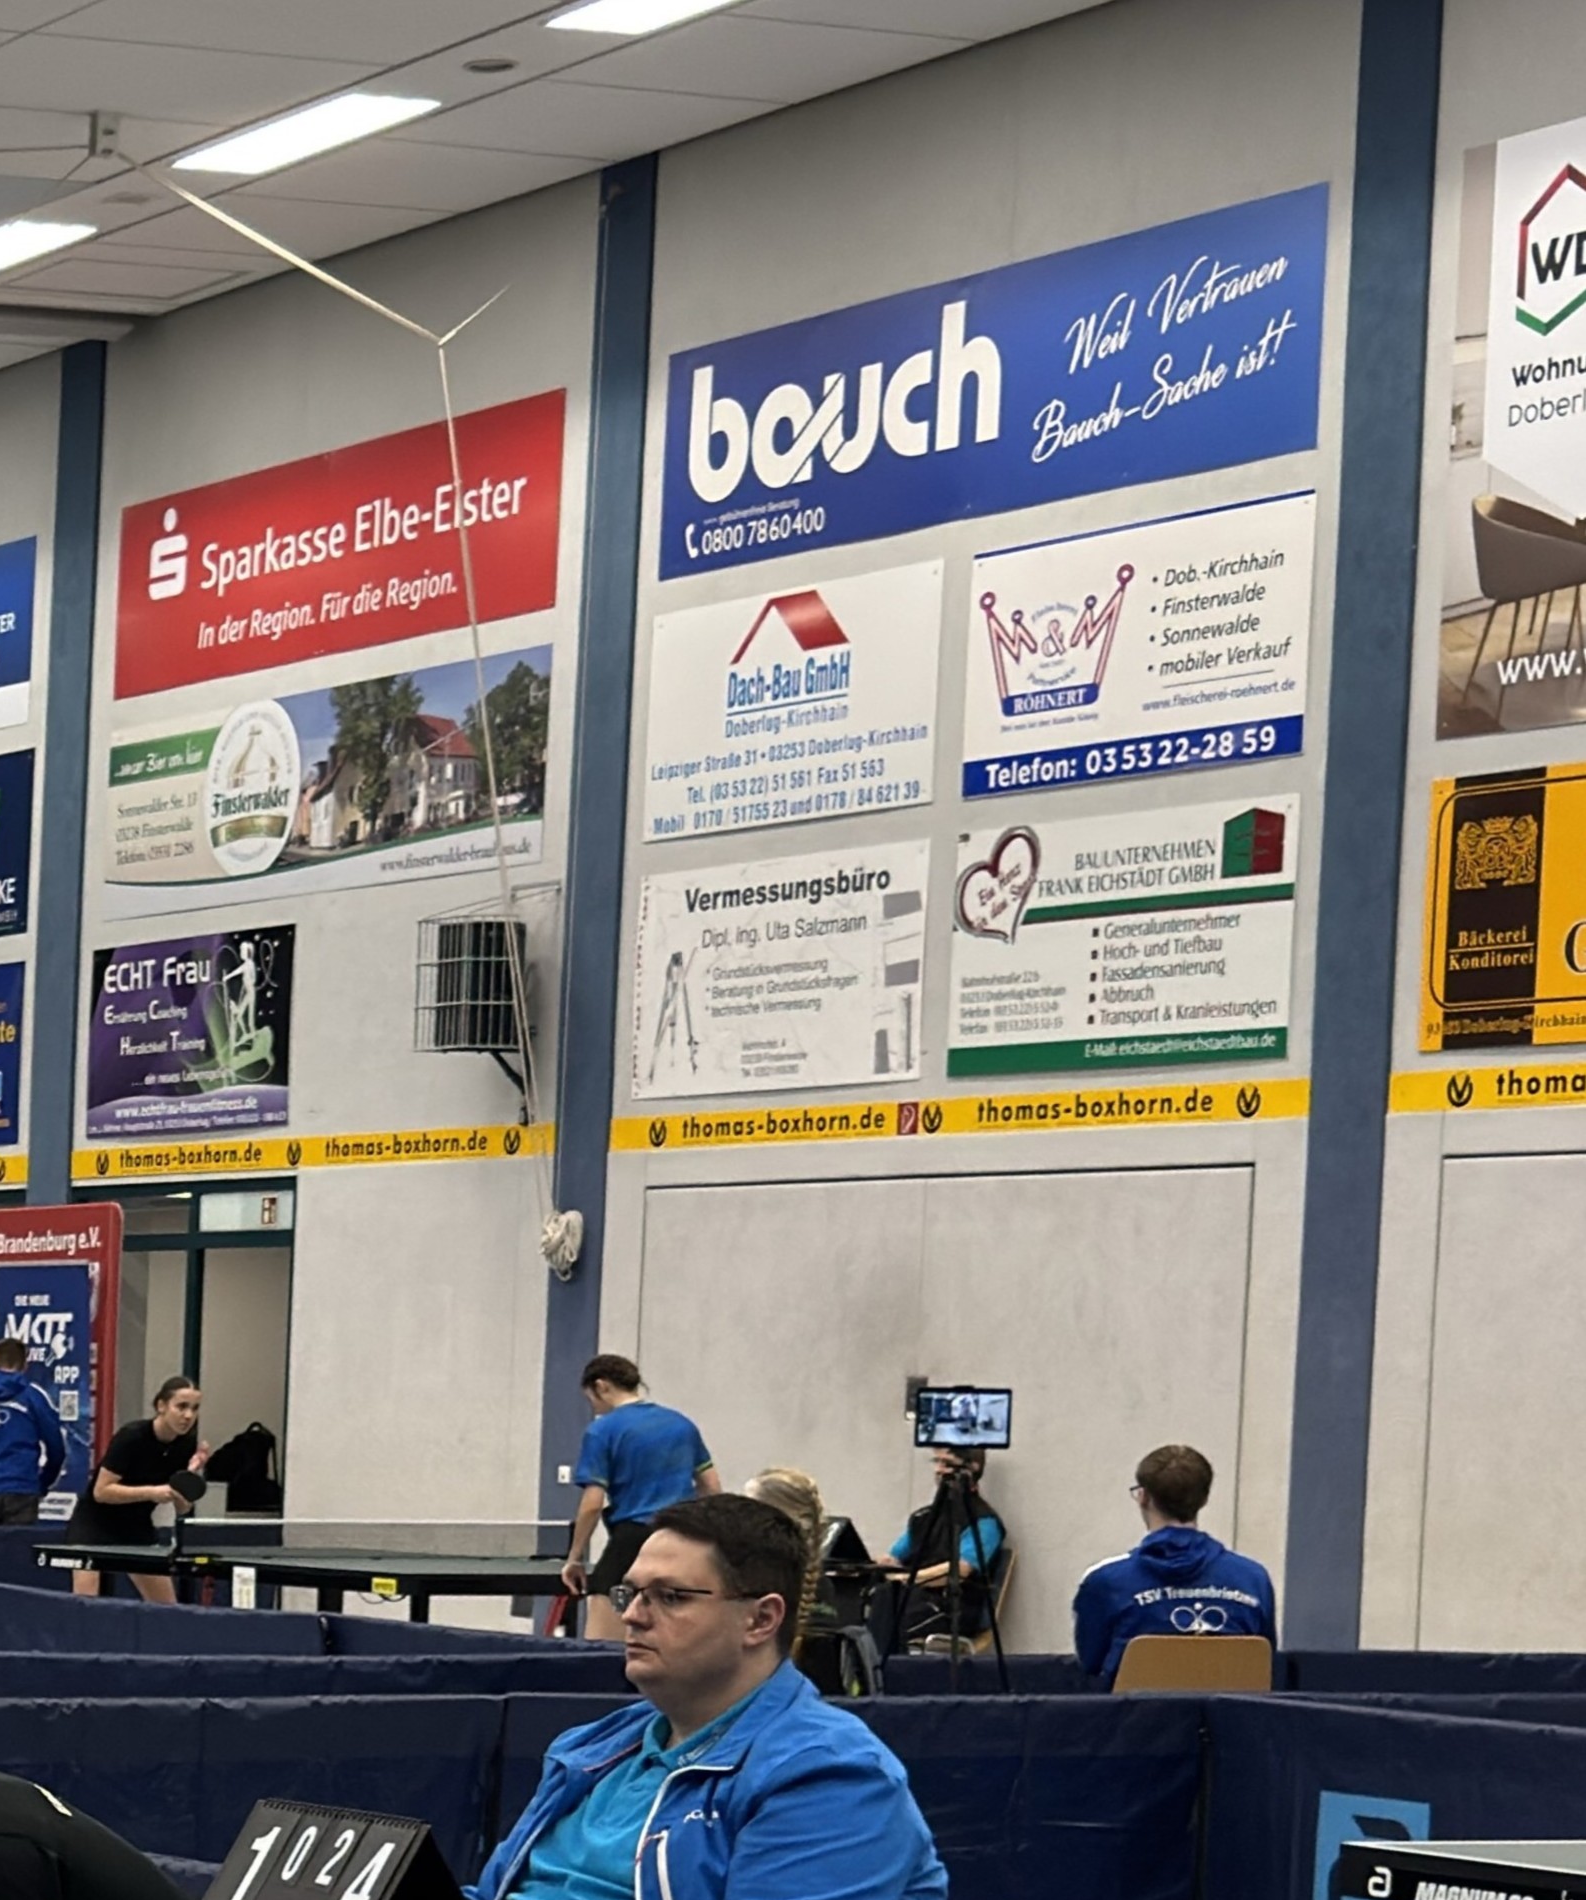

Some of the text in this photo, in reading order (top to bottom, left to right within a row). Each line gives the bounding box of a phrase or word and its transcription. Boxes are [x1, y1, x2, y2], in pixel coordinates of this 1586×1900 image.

[1064, 254, 1288, 375] Weil Vertrauen
[688, 300, 1002, 503] bauch
[1031, 309, 1298, 463] Bauch-Sache ist!
[200, 475, 529, 596] Sparkasse Elbe-Elster
[701, 523, 744, 555] 0800
[746, 506, 825, 546] 7860400
[1164, 549, 1285, 587] Dob.-Kirchhain
[197, 569, 458, 649] In der Region. Für die Region.
[1161, 582, 1266, 618] Finsterwalde
[1160, 612, 1261, 648] Sonnewalde
[1159, 636, 1292, 677] mobiler Verkauf
[1497, 648, 1586, 686] www.
[727, 650, 851, 709] Dach-Bau GmbH
[1013, 687, 1087, 714] RÖHNERT
[725, 703, 849, 739] Doberlug-Kirchhain
[651, 762, 701, 782] Leipziger
[704, 752, 742, 773] Straße
[768, 740, 805, 762] 03253
[808, 724, 927, 756] Doberlug-Kirchhain
[985, 757, 1078, 789] Telefon:
[1157, 733, 1235, 764] 22-28
[1242, 725, 1277, 753] 59
[687, 786, 706, 804] Tel.
[731, 779, 747, 798] 53
[772, 772, 786, 792] 51
[817, 766, 838, 785] Fax
[841, 761, 856, 782] 51
[859, 757, 885, 779] 563
[653, 814, 685, 835] Mobil
[772, 799, 788, 819] 23
[790, 795, 812, 816] und
[903, 779, 920, 800] 39
[1074, 838, 1217, 872] BAUUNTERNEHMEN
[685, 867, 891, 913] Vermessungsbüro
[1038, 863, 1216, 899] FRANK EICHSTÄDT GMBH
[766, 920, 790, 942] Uta
[794, 913, 867, 938] Salzmann
[1103, 912, 1241, 941] Generalunternehmer
[1457, 925, 1527, 948] Bäckerei
[1143, 939, 1170, 958] und
[1174, 935, 1223, 955] Tiefbau
[1448, 948, 1535, 971] Konditorei
[103, 955, 211, 994] ECHT Frau
[1102, 957, 1226, 984] Fassadensanierung
[1101, 982, 1155, 1003] Abbruch
[1099, 999, 1277, 1026] Transport & Kranleistungen
[1496, 1069, 1586, 1097] thoma
[682, 1106, 886, 1139] thomas-boxhorn.de
[978, 1088, 1213, 1123] thomas-boxhorn.de
[119, 1143, 262, 1169] thomas-boxhorn.de
[325, 1130, 488, 1158] thomas-boxhorn.de
[78, 1226, 102, 1249] e.V.
[26, 1346, 46, 1362] IVE
[54, 1366, 79, 1384] APP
[1134, 1587, 1162, 1606] TSV
[281, 1825, 318, 1881] 0
[314, 1828, 355, 1886] 2
